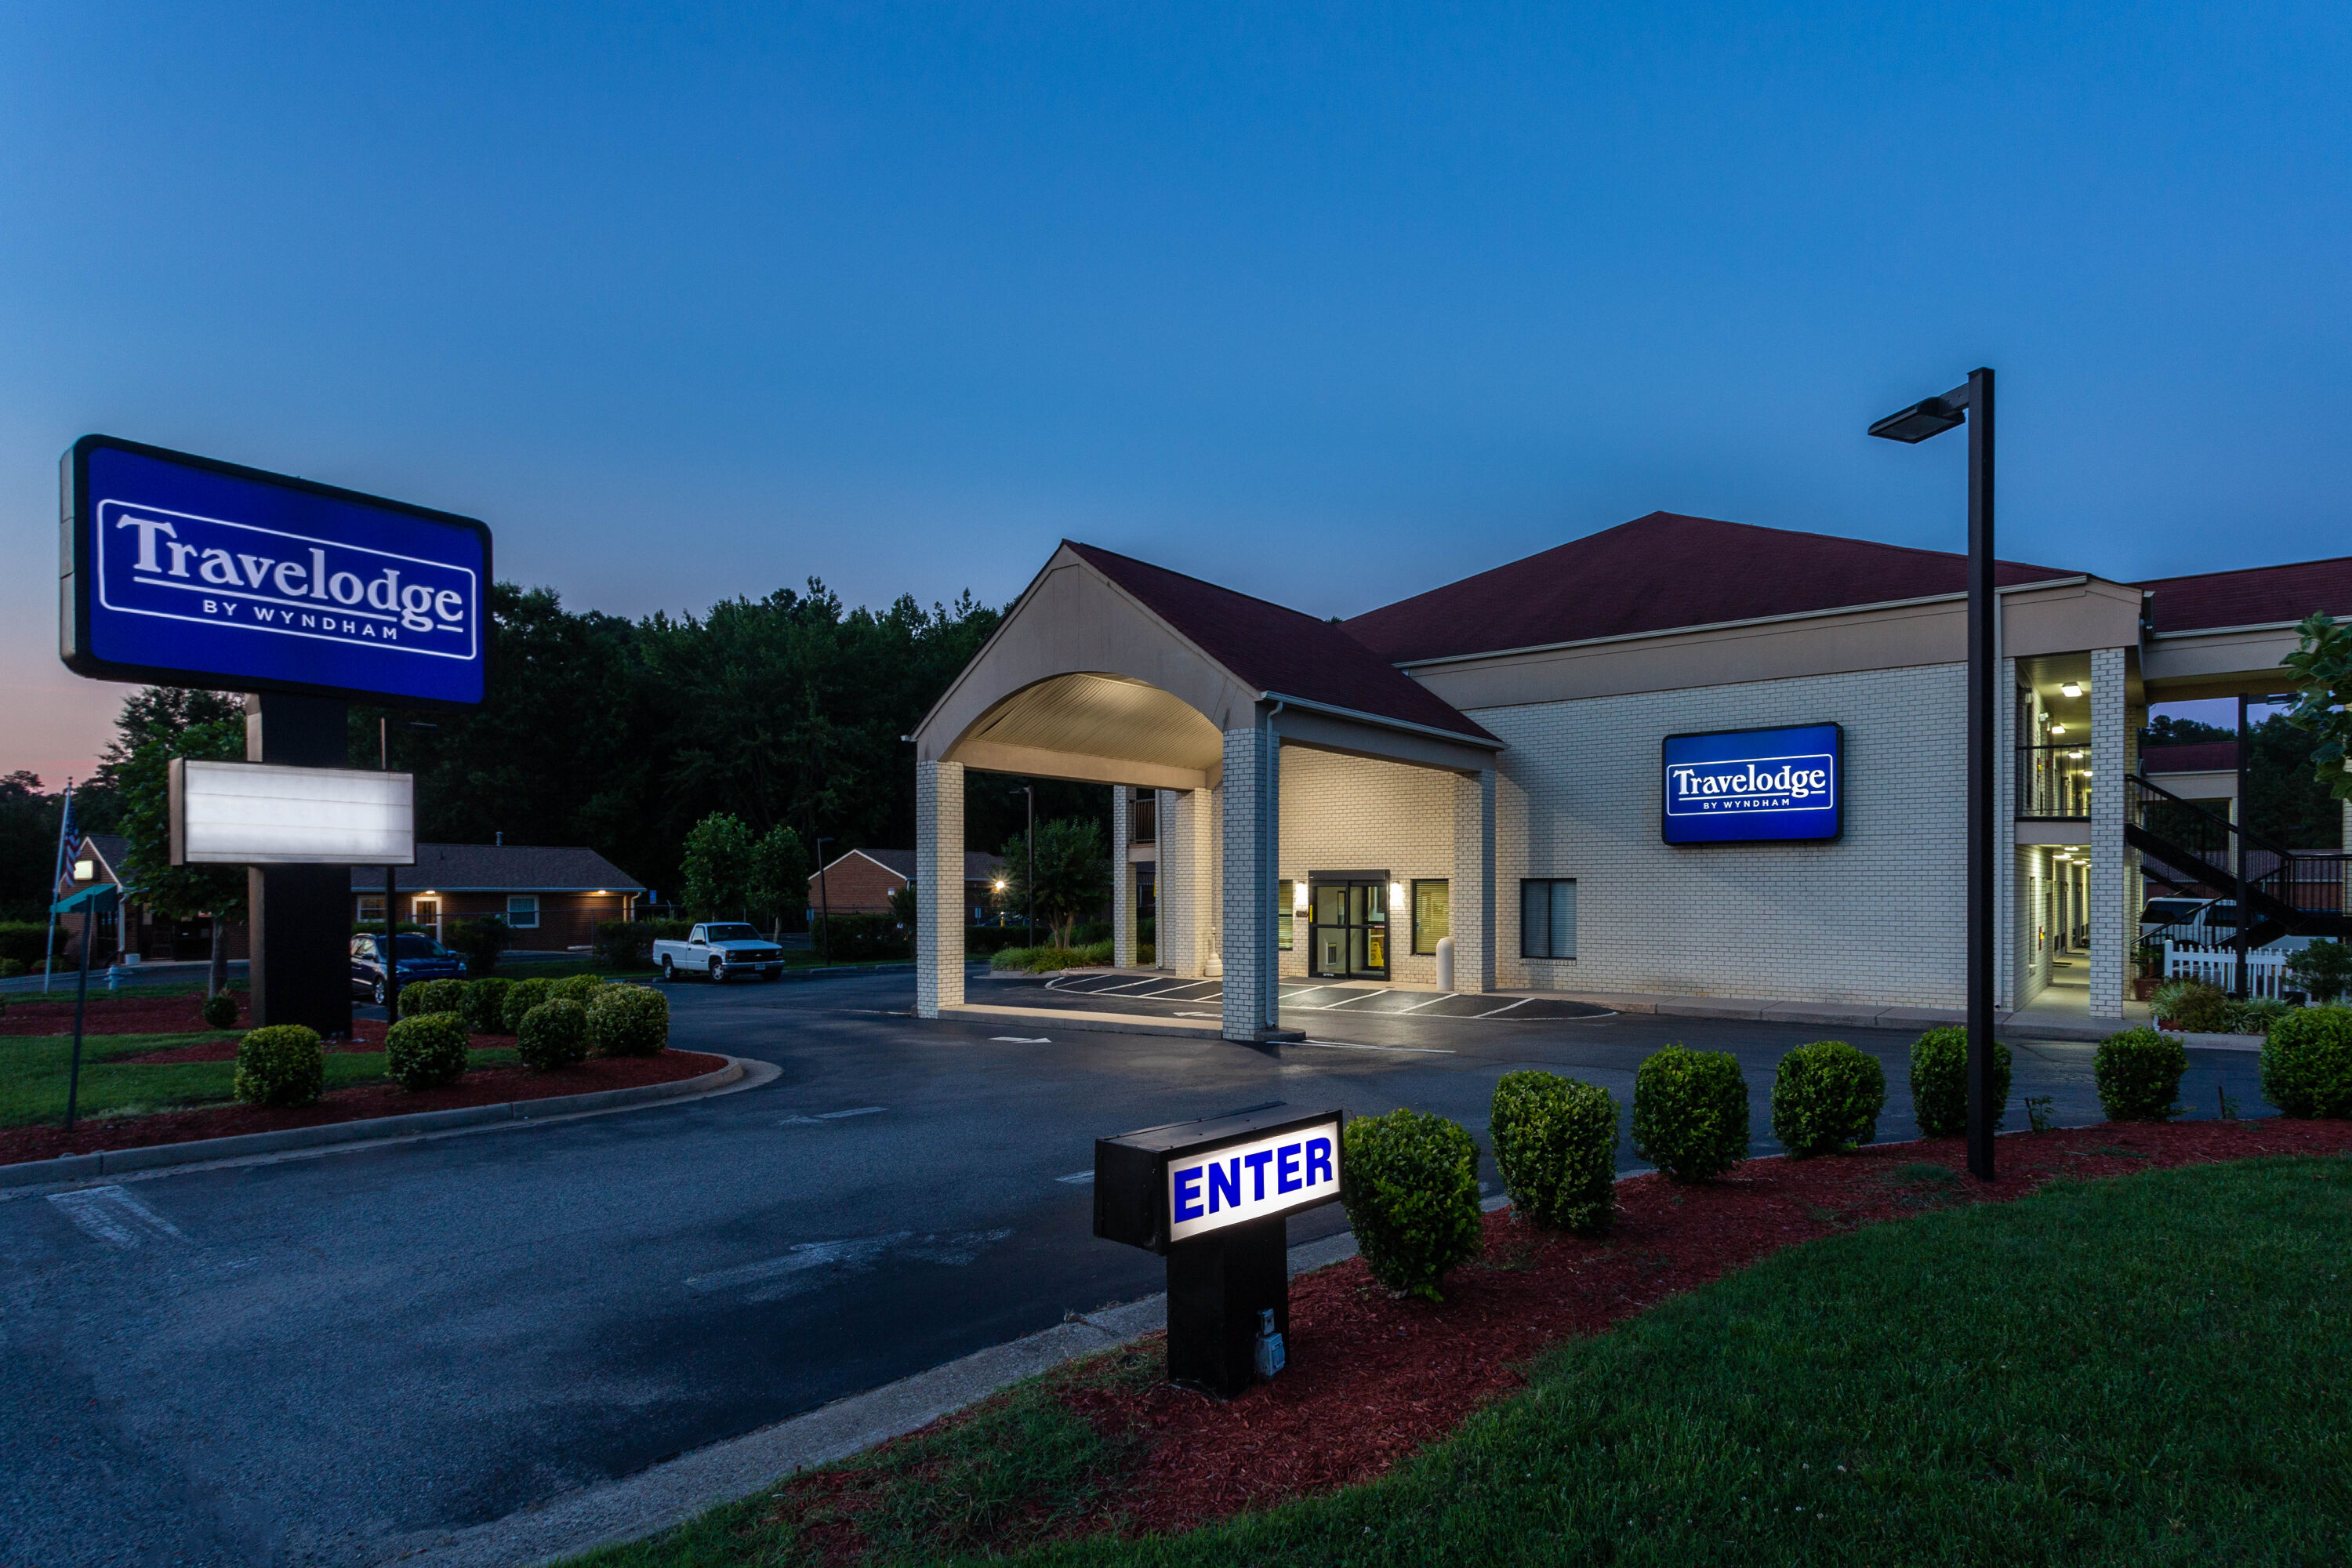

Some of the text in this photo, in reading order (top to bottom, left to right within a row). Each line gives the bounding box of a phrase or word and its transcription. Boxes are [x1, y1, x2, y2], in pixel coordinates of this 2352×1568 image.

[116, 514, 464, 633] Travelodge
[203, 599, 397, 640] BY WYNDHAM
[1672, 764, 1826, 798] Travelodge
[1703, 798, 1790, 810] BY WYNDHAM
[1174, 1137, 1333, 1224] ENTER
